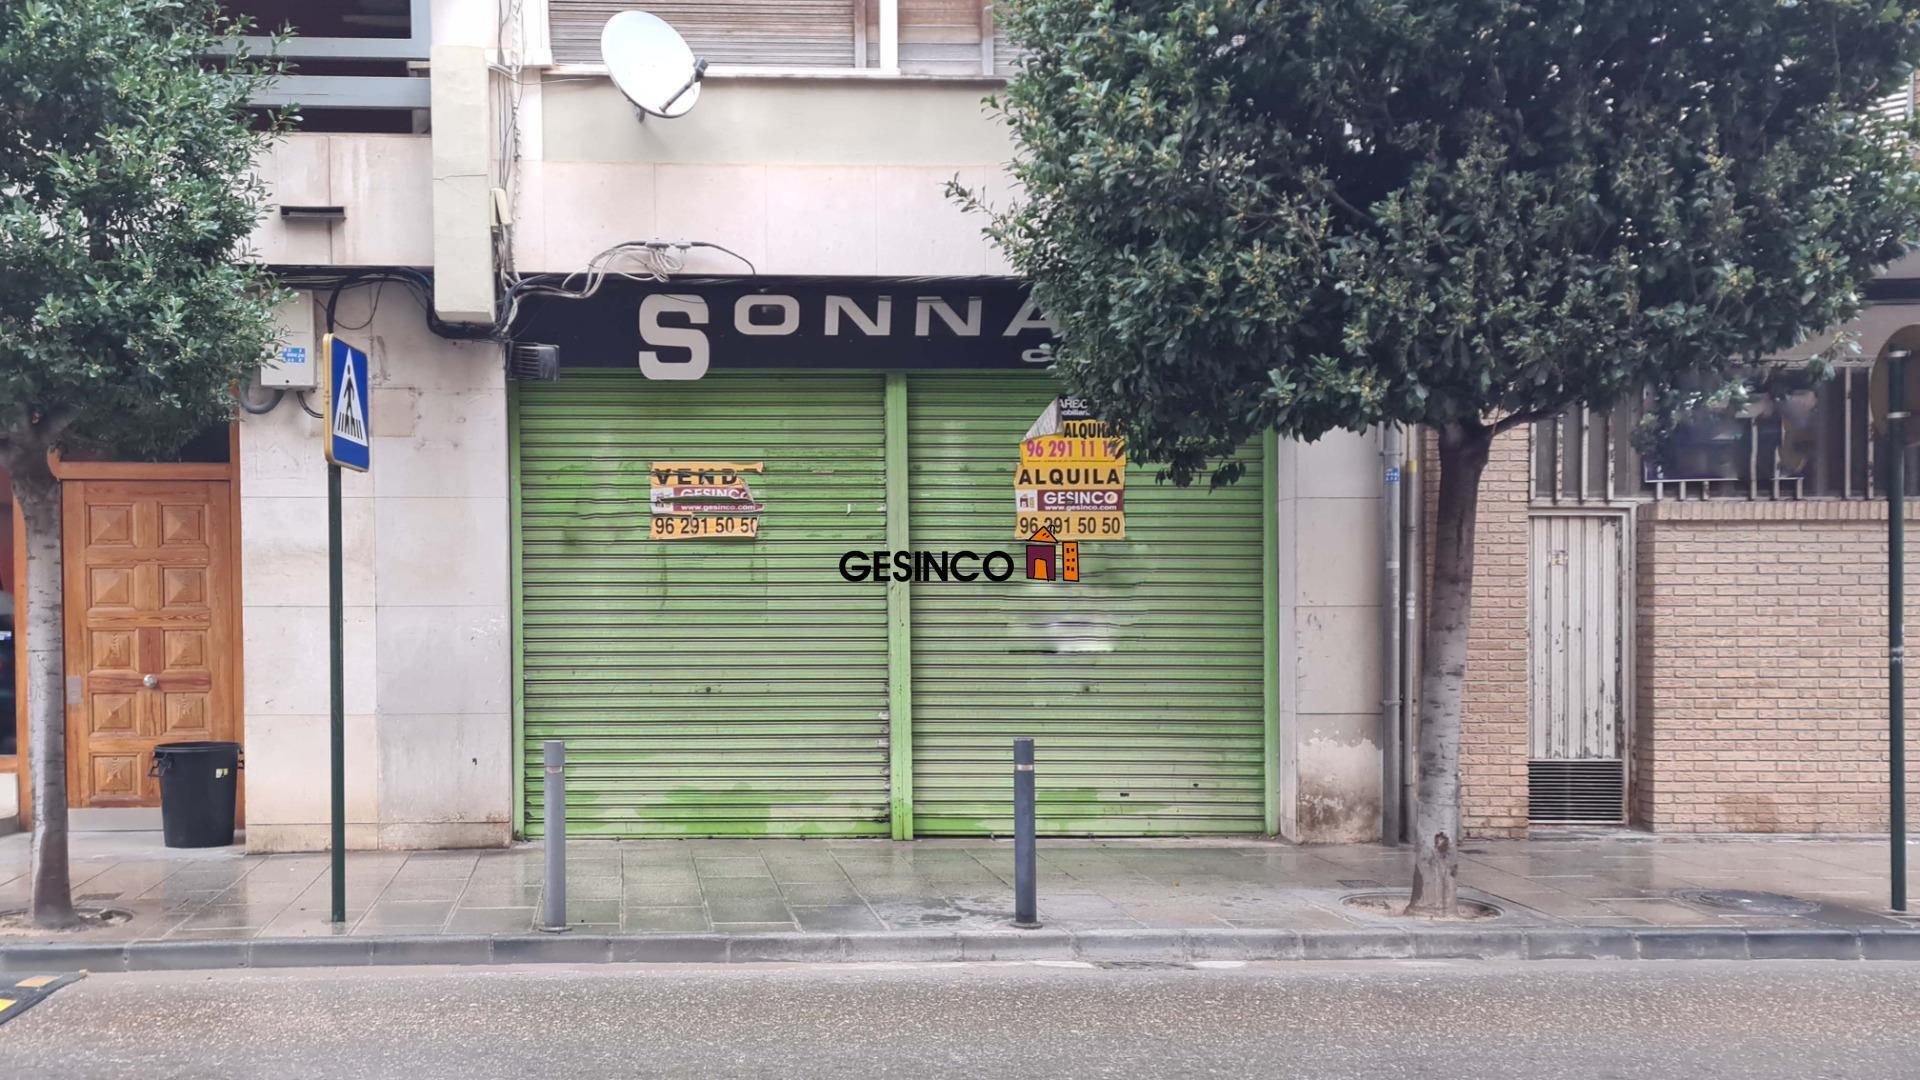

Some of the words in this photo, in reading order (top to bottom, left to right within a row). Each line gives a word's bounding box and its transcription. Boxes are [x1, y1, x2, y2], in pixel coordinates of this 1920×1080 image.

[1063, 422, 1121, 439] ALQUIL
[1026, 440, 1044, 458] 96
[1048, 440, 1073, 458] 291
[1081, 440, 1095, 458] 11
[654, 468, 758, 485] VEND
[1018, 468, 1121, 486] ALQUILA
[1043, 491, 1119, 505] GESINCO
[680, 502, 756, 512] www.gesinco.com
[1044, 504, 1117, 512] www.gesinco.com
[655, 517, 675, 534] 96
[680, 517, 708, 534] 291
[715, 517, 735, 534] 50
[1020, 516, 1039, 534] 96
[1078, 516, 1097, 534] 50
[1102, 516, 1121, 534] 50
